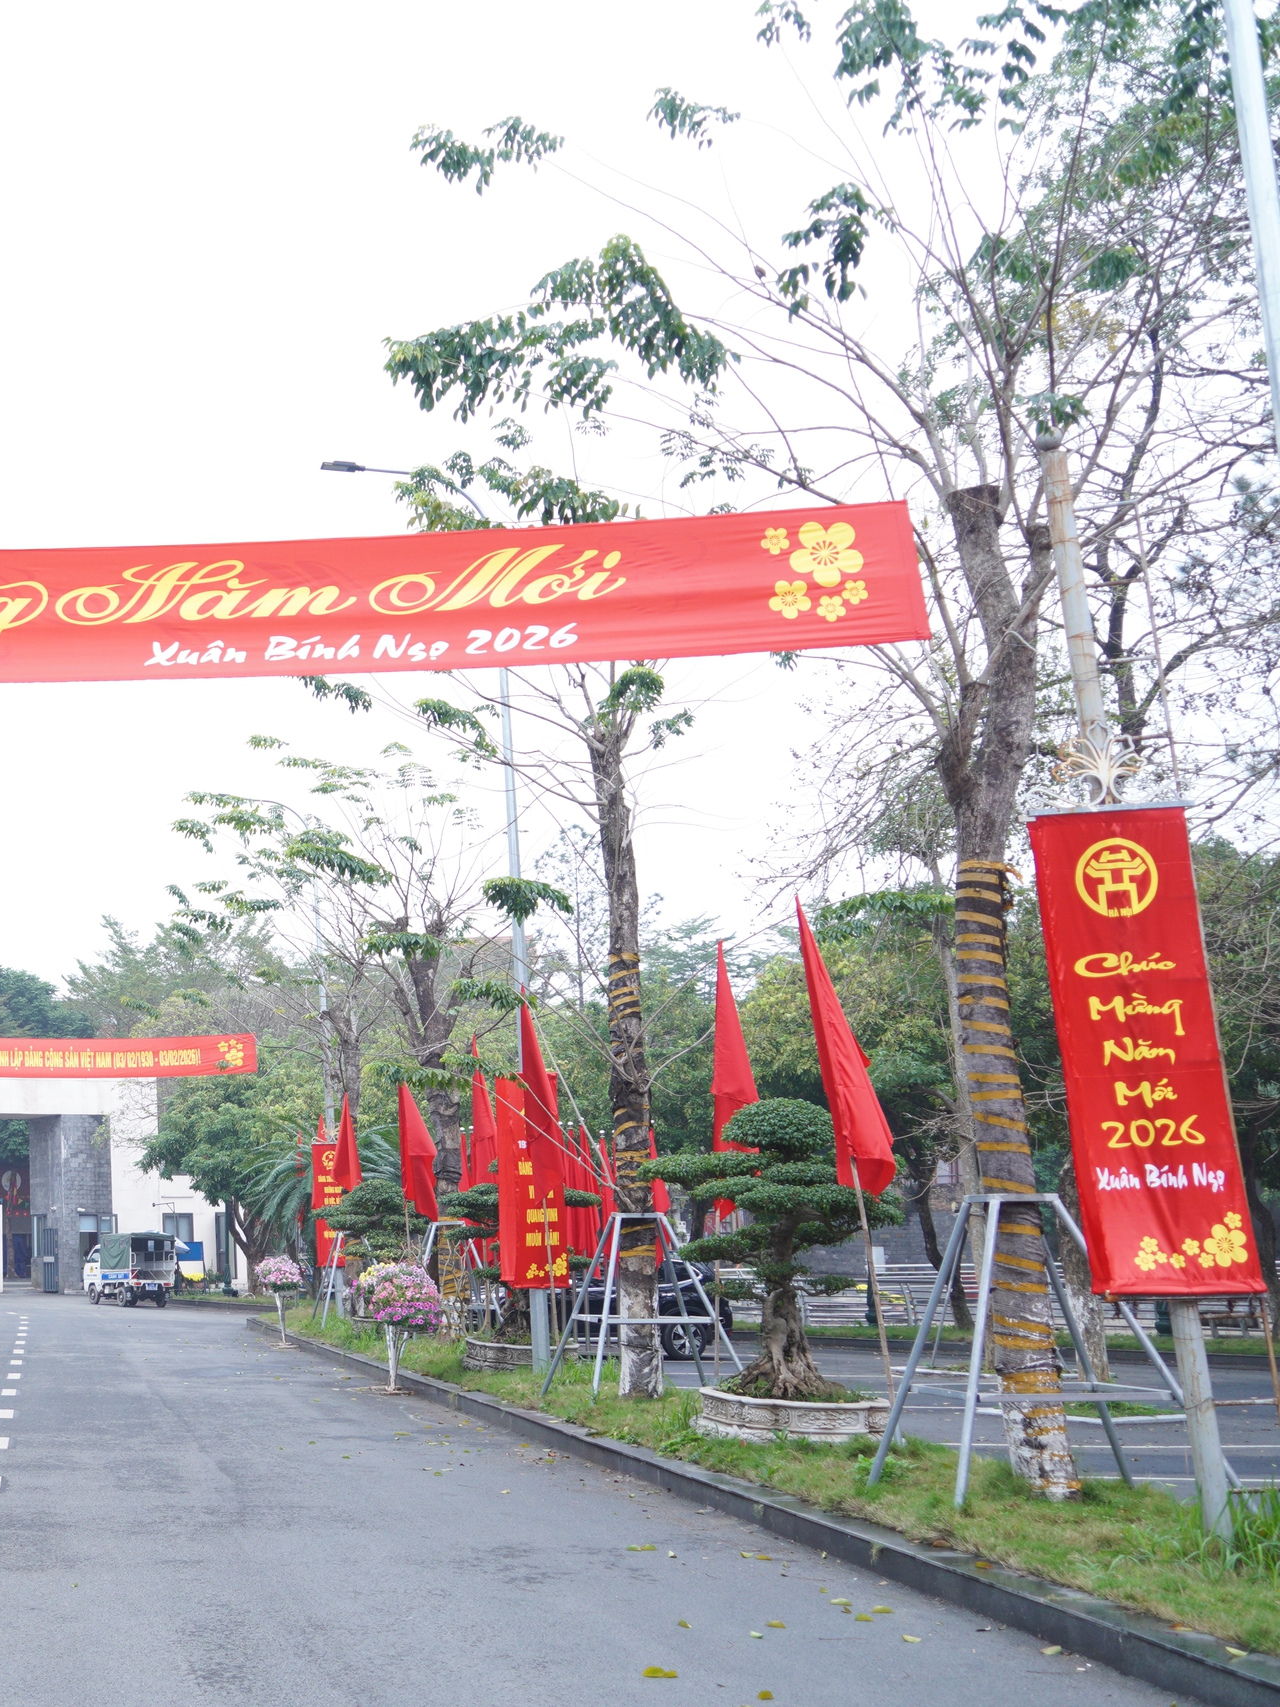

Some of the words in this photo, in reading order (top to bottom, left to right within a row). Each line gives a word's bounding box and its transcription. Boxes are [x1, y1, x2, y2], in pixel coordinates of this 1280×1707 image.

[55, 559, 358, 626] Năm
[368, 543, 628, 616] Mới
[142, 640, 250, 670] Xuân
[264, 634, 362, 664] Bính
[368, 633, 449, 665] Ngọ
[465, 623, 578, 655] 2026
[1075, 952, 1176, 977] Chúc
[1088, 992, 1186, 1036] Mừng
[10, 1047, 23, 1071] LẬP
[24, 1045, 44, 1068] ĐẢNG
[44, 1047, 64, 1071] CỘNG
[64, 1045, 80, 1068] SẢN
[80, 1048, 95, 1072] VIỆT
[95, 1051, 112, 1068] NAM
[159, 1048, 201, 1067] 03/02/2026)!
[1103, 1037, 1176, 1066] Năm
[1115, 1079, 1177, 1108] Mới
[1102, 1115, 1205, 1148] 2026
[517, 1157, 533, 1176] ĐẢNG
[1096, 1167, 1140, 1190] Xuân
[1145, 1164, 1187, 1188] Bính
[1193, 1163, 1224, 1192] Ngọ
[526, 1208, 545, 1225] QUANG
[525, 1230, 542, 1247] MUÔN
